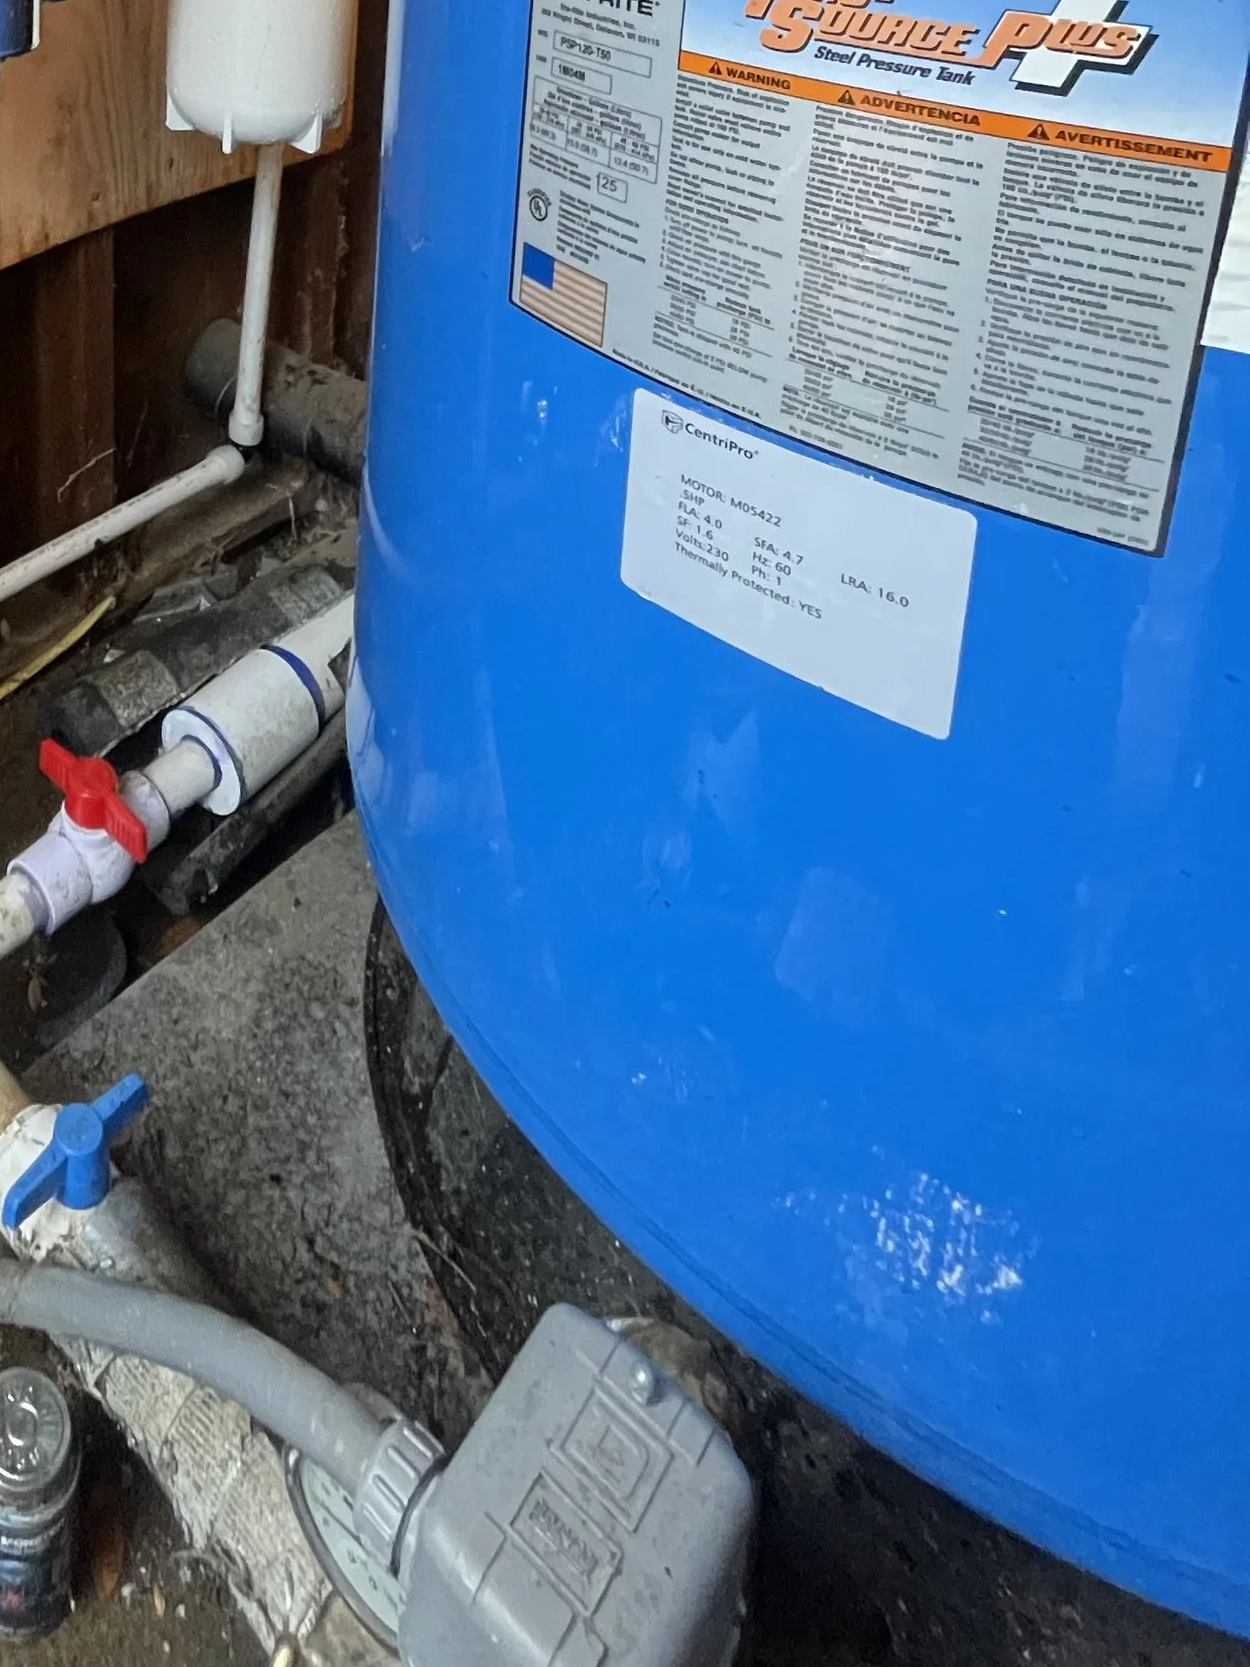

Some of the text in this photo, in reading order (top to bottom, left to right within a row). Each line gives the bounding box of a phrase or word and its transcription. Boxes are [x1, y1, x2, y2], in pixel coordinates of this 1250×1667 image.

[725, 67, 791, 90] WARNING
[813, 46, 977, 86] Steel Pressure Tank
[860, 94, 982, 127] ADVERTENCIA
[1055, 130, 1213, 163] AVERTISSEMENT
[685, 423, 754, 460] CentriPro
[678, 501, 723, 530] FLA: 4.0
[680, 474, 781, 527] MOTOR: M05422
[696, 524, 713, 540] 1.6
[752, 551, 792, 576] Hz: 60
[754, 537, 804, 565] SFA: 4.7
[675, 542, 822, 619] Thermally Protected: YES
[751, 566, 782, 586] Ph: 1
[841, 574, 909, 608] LRA: 16.0
